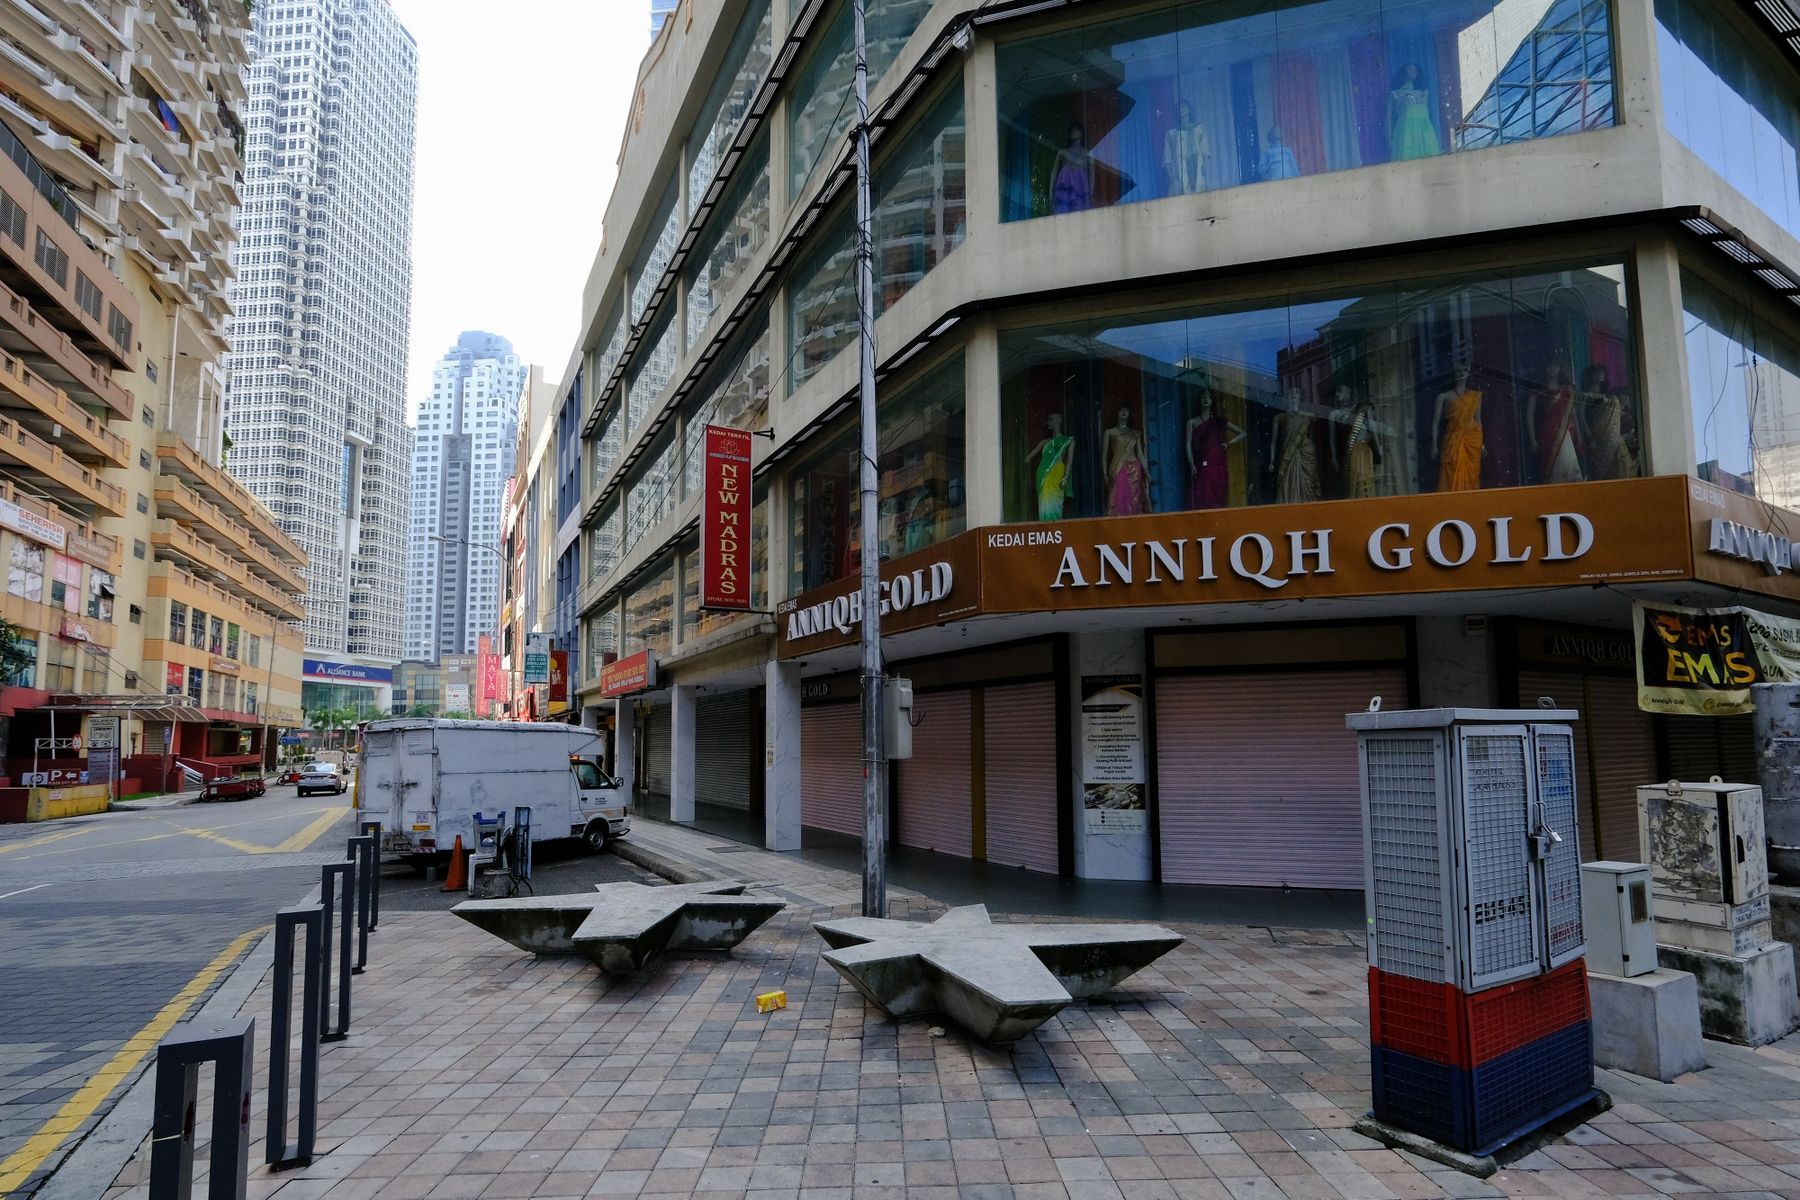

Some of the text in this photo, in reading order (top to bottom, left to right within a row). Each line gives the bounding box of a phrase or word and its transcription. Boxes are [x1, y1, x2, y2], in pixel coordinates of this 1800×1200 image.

[718, 463, 741, 505] NEW
[1690, 483, 1726, 509] KEDAI EMAS
[18, 508, 64, 535] SEHERISH
[719, 511, 739, 594] MADRAS
[987, 530, 1063, 548] KEDAI EMAS
[1048, 512, 1596, 590] ANNIQH GOLD
[1708, 517, 1793, 577] ANNIQH
[786, 589, 863, 641] ANNIQH
[1551, 635, 1635, 663] ANNIQH GOL
[327, 667, 366, 678] ALLIANCE BANK
[487, 655, 497, 691] MAYA
[808, 684, 828, 697] GOLD
[50, 770, 63, 781] P
